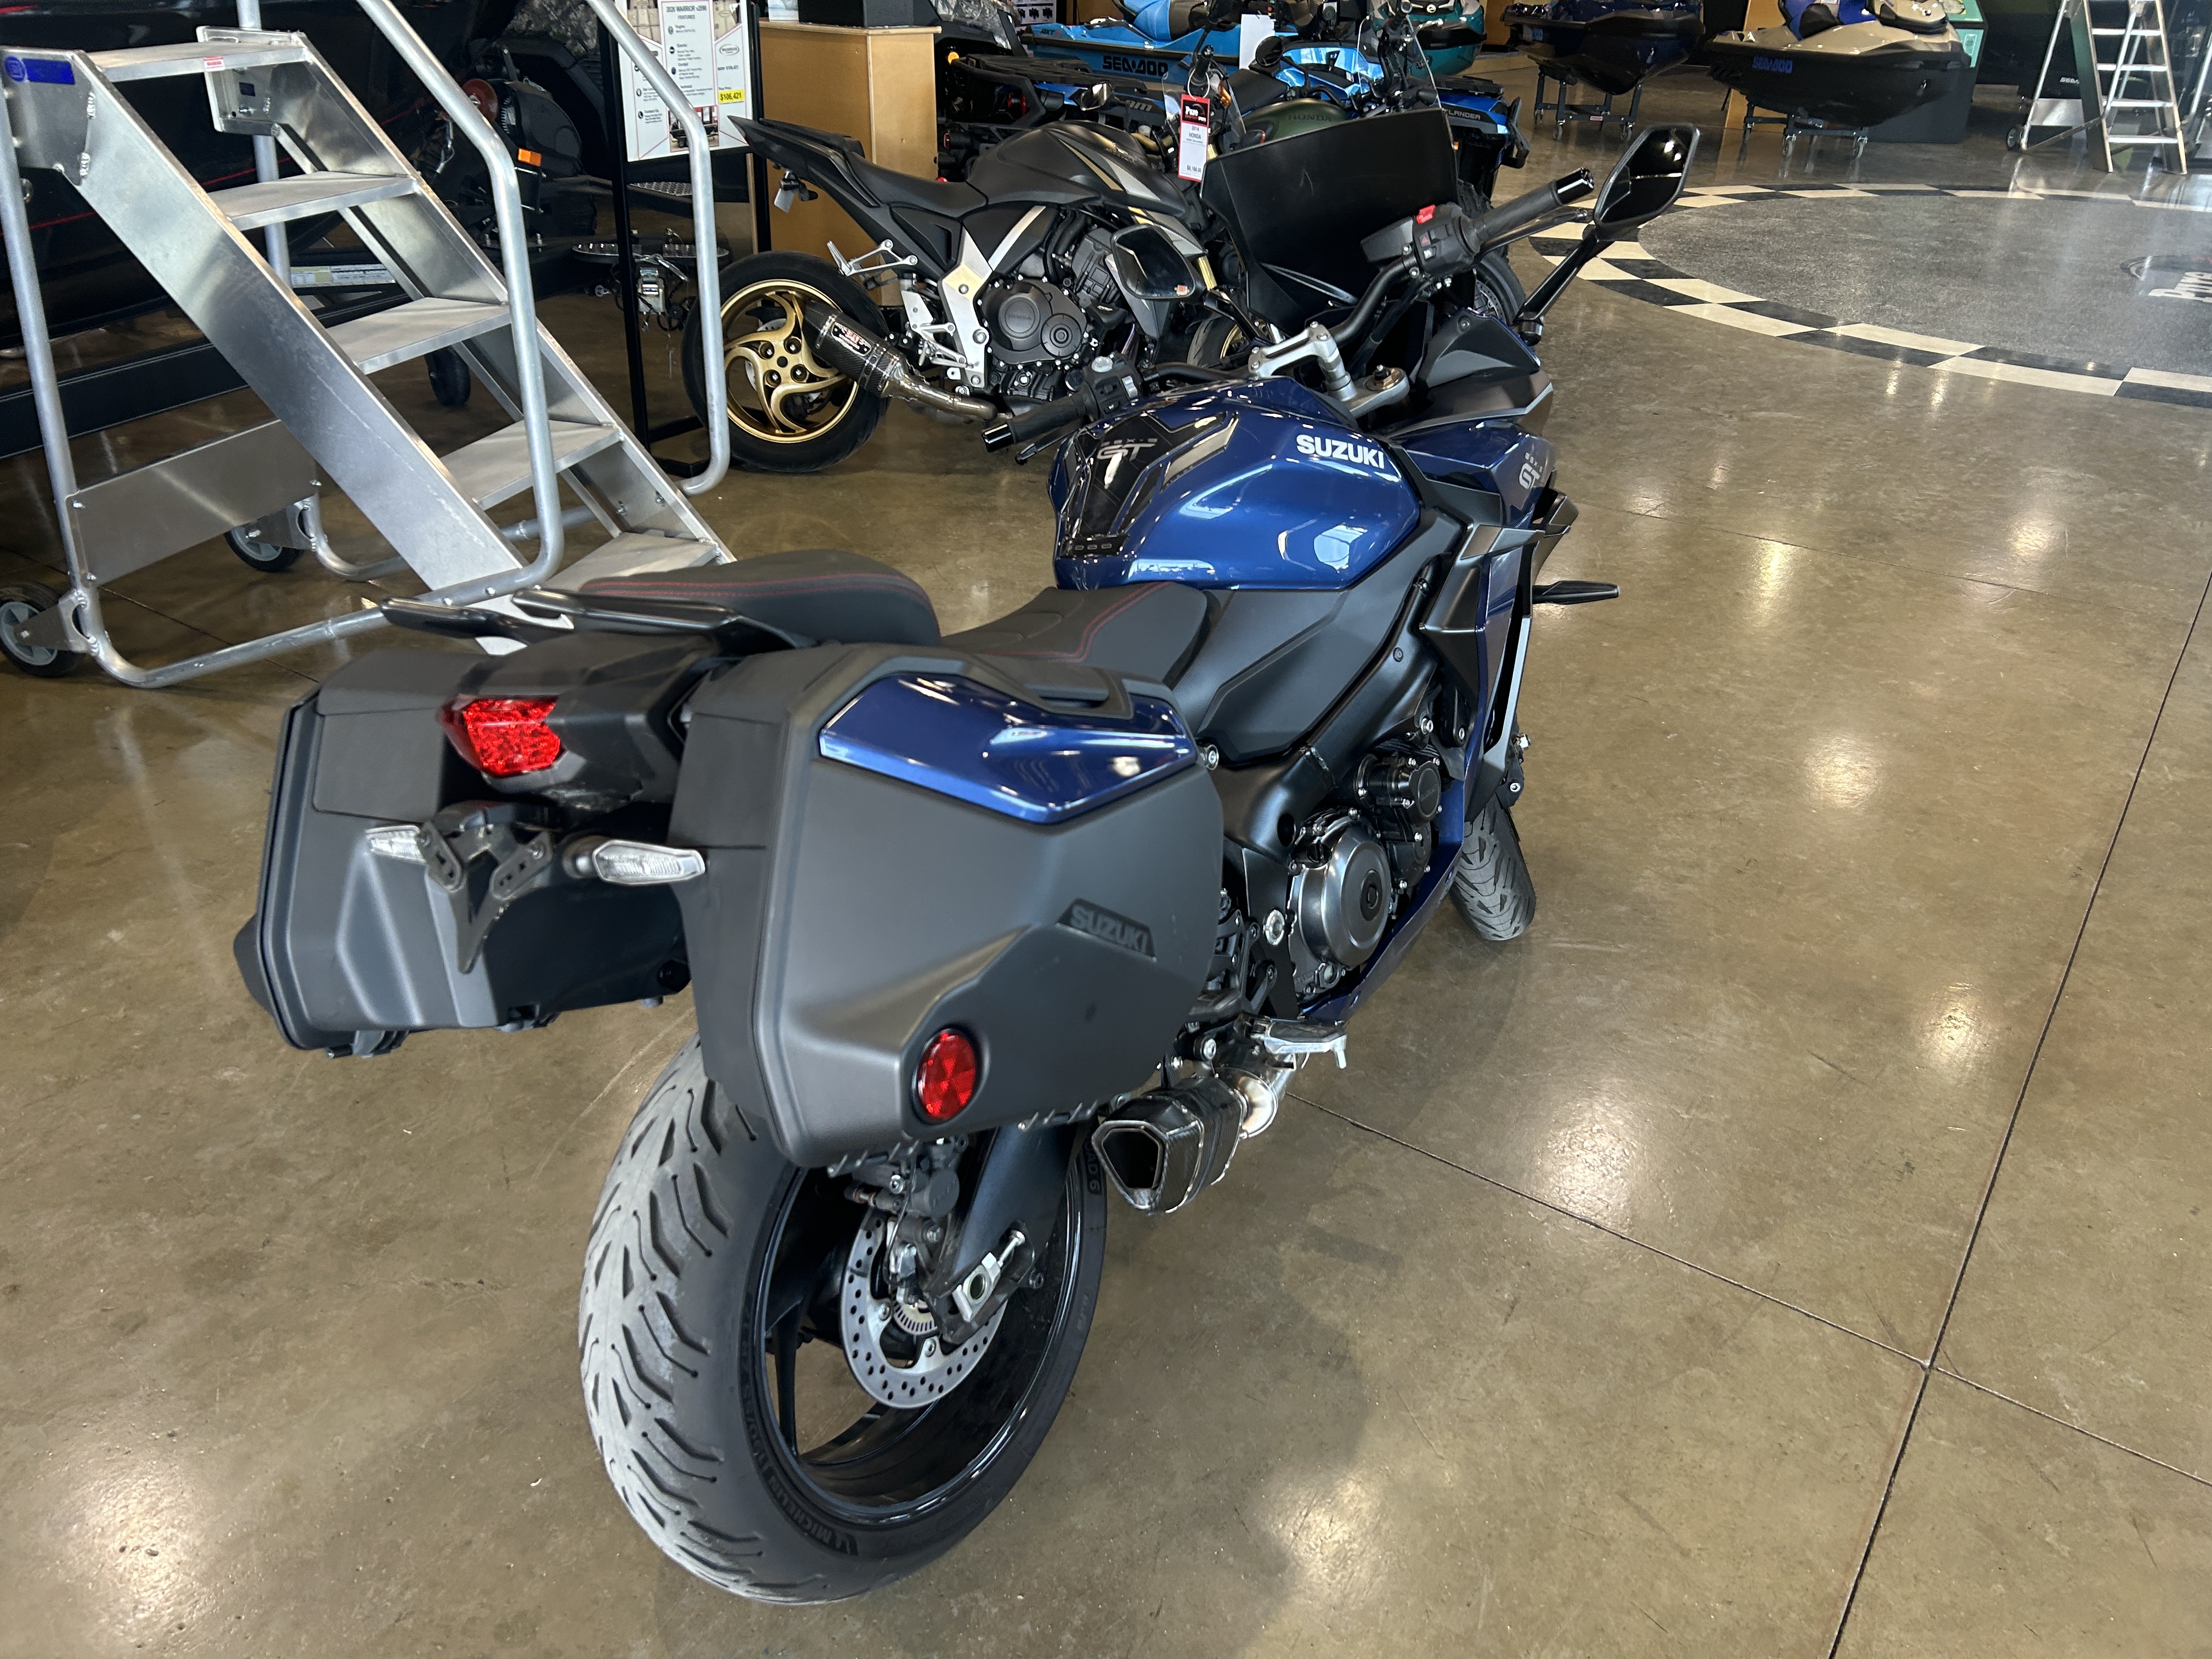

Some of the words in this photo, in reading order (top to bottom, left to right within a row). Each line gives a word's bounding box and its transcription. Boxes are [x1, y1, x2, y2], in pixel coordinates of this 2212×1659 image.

[720, 92, 742, 101] $106,421
[1288, 114, 1333, 122] HONDA
[1446, 109, 1481, 120] LANDER
[1297, 434, 1385, 469] SUZUKI
[1069, 905, 1148, 955] SUZUKI
[769, 1475, 833, 1544] MICHELIN
